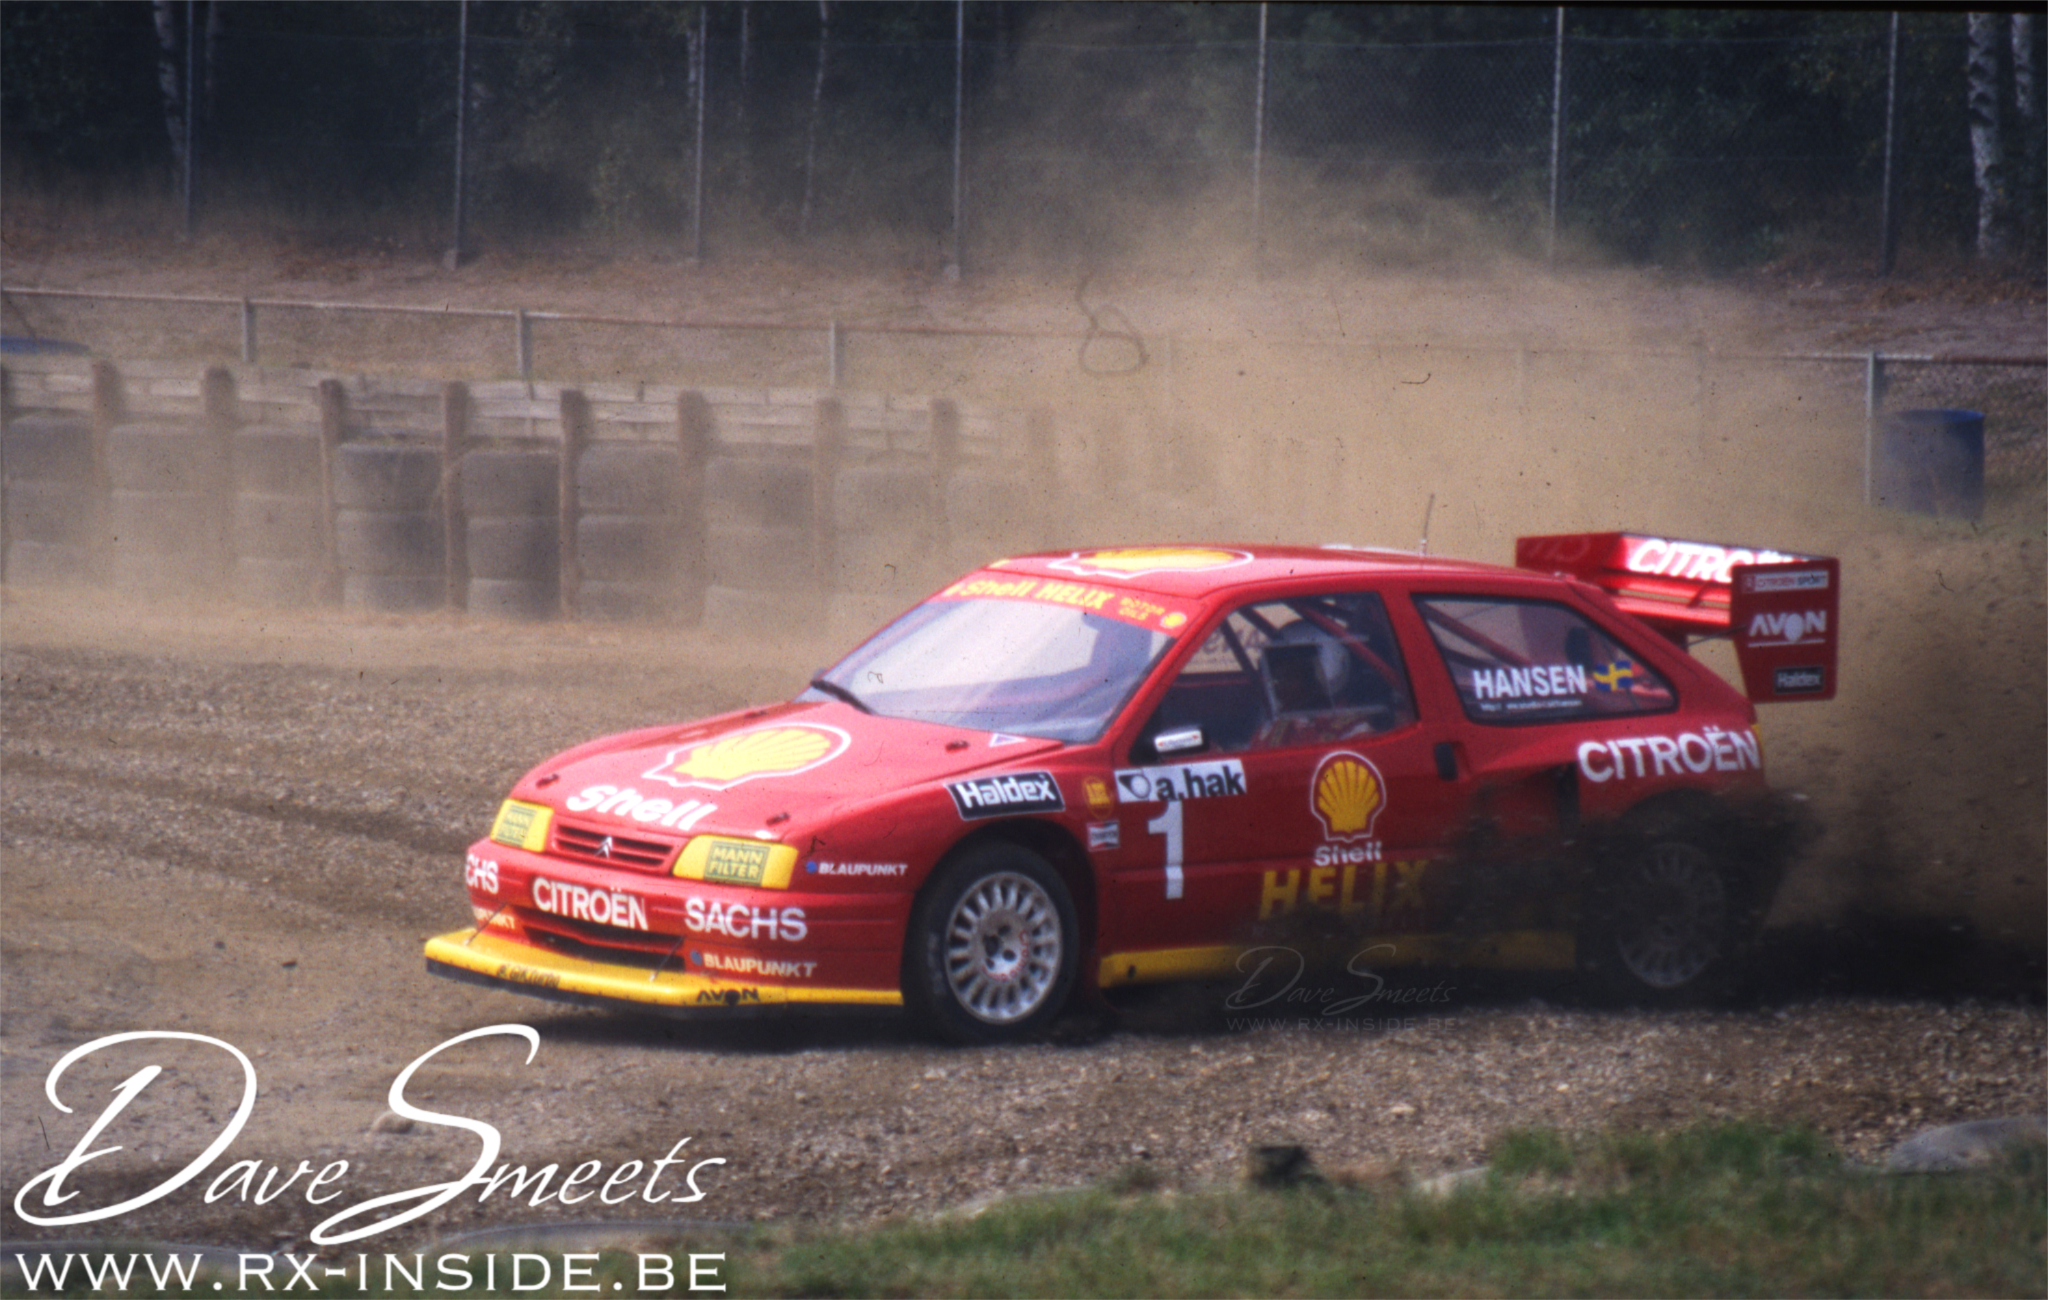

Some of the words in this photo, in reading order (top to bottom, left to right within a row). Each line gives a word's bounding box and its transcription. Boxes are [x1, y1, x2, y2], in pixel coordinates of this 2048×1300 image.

[960, 579, 1037, 597] Shell
[1035, 581, 1115, 610] HELIX
[1750, 610, 1827, 643] AVON
[1472, 664, 1588, 699] HANSEN
[1776, 670, 1822, 689] Haldex
[1577, 725, 1762, 783] CITROËN
[955, 776, 1057, 809] Haldex
[1155, 764, 1247, 801] a.hak
[566, 785, 718, 831] Shell
[712, 847, 764, 864] MANN
[1147, 800, 1184, 900] 1
[1313, 841, 1383, 867] Shell
[708, 860, 761, 879] FILTER
[818, 862, 908, 877] BLAUPUNKT
[532, 876, 648, 931] CITROËN
[1258, 860, 1430, 921] HELIX
[684, 898, 808, 941] SACHS
[703, 953, 818, 978] BLAUPUNKT
[696, 987, 761, 1006] AVON
